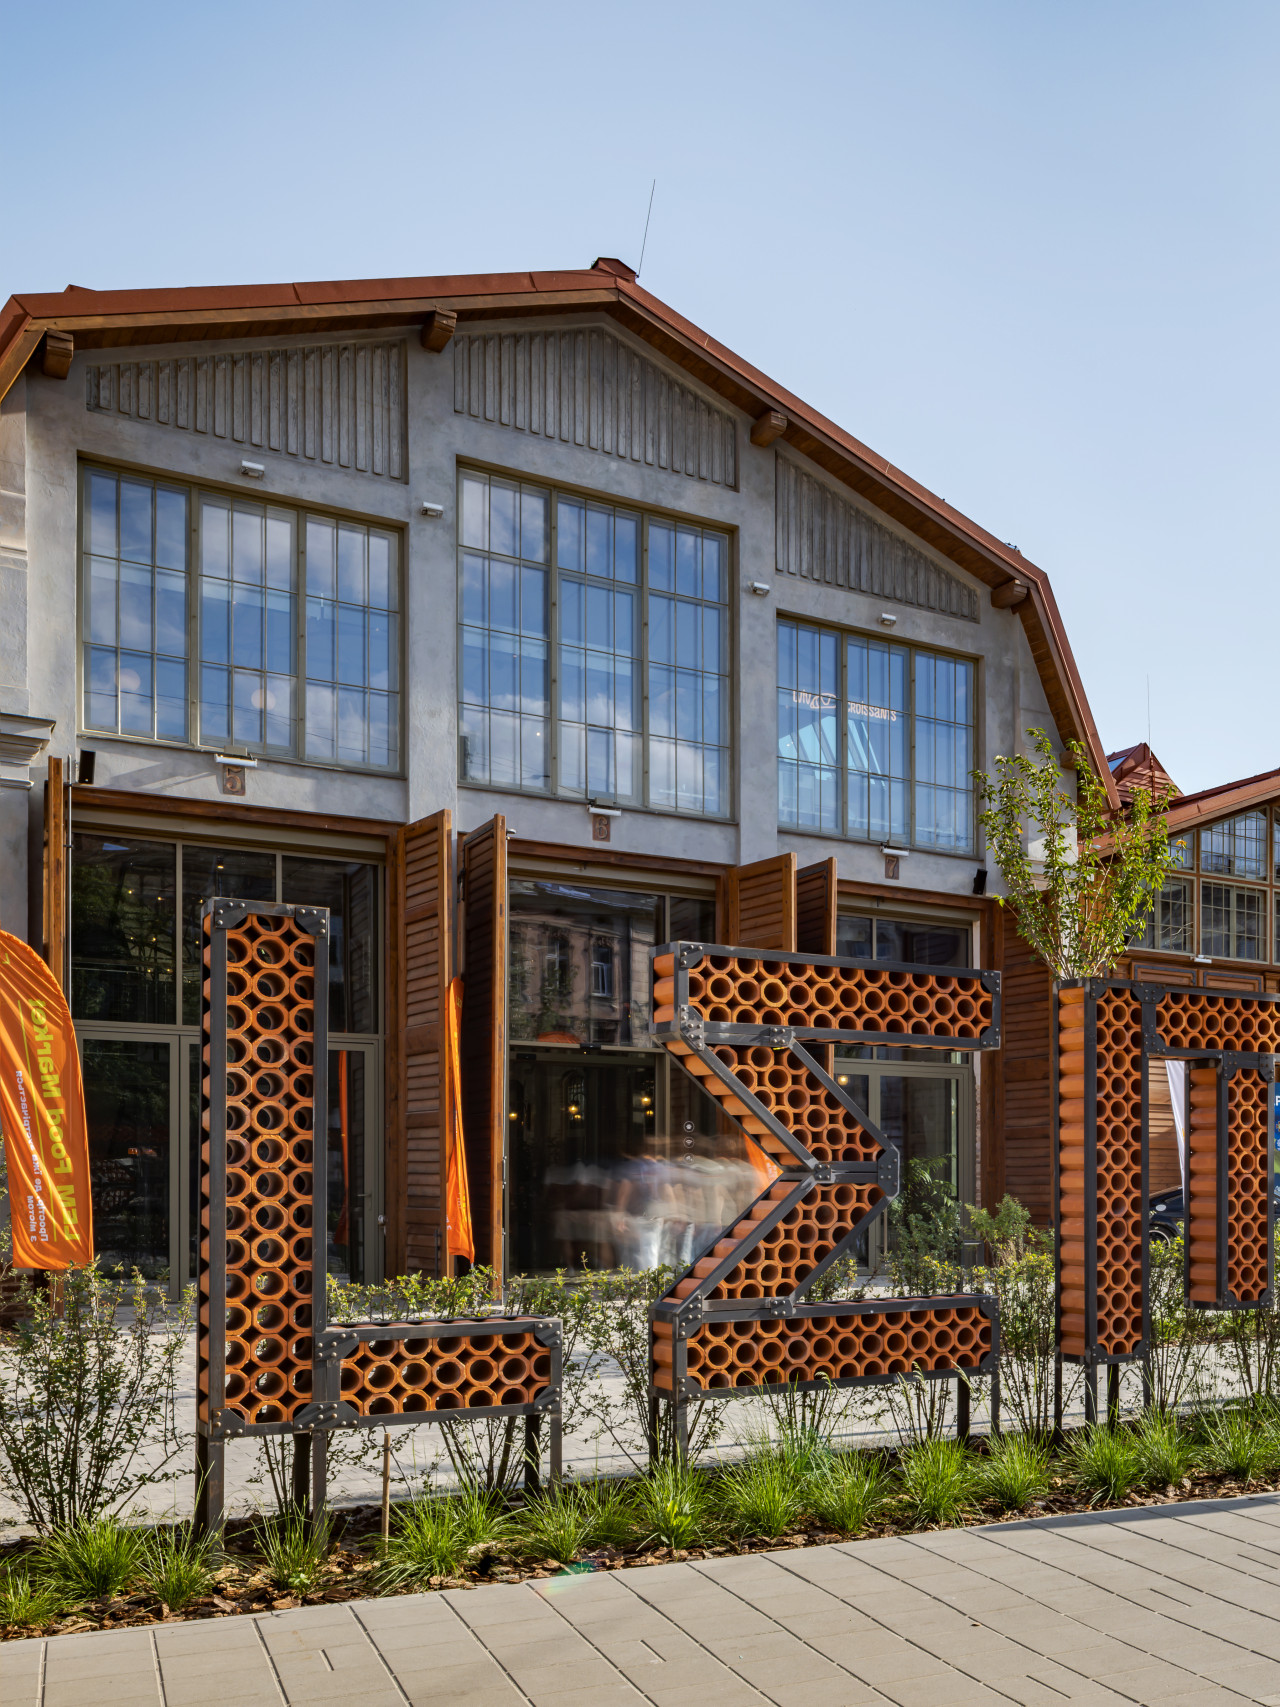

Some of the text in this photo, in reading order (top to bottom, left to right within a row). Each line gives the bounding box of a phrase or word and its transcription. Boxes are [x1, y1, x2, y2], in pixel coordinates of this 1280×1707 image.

[226, 767, 242, 791] 5
[596, 816, 608, 839] 6
[886, 856, 897, 878] 7
